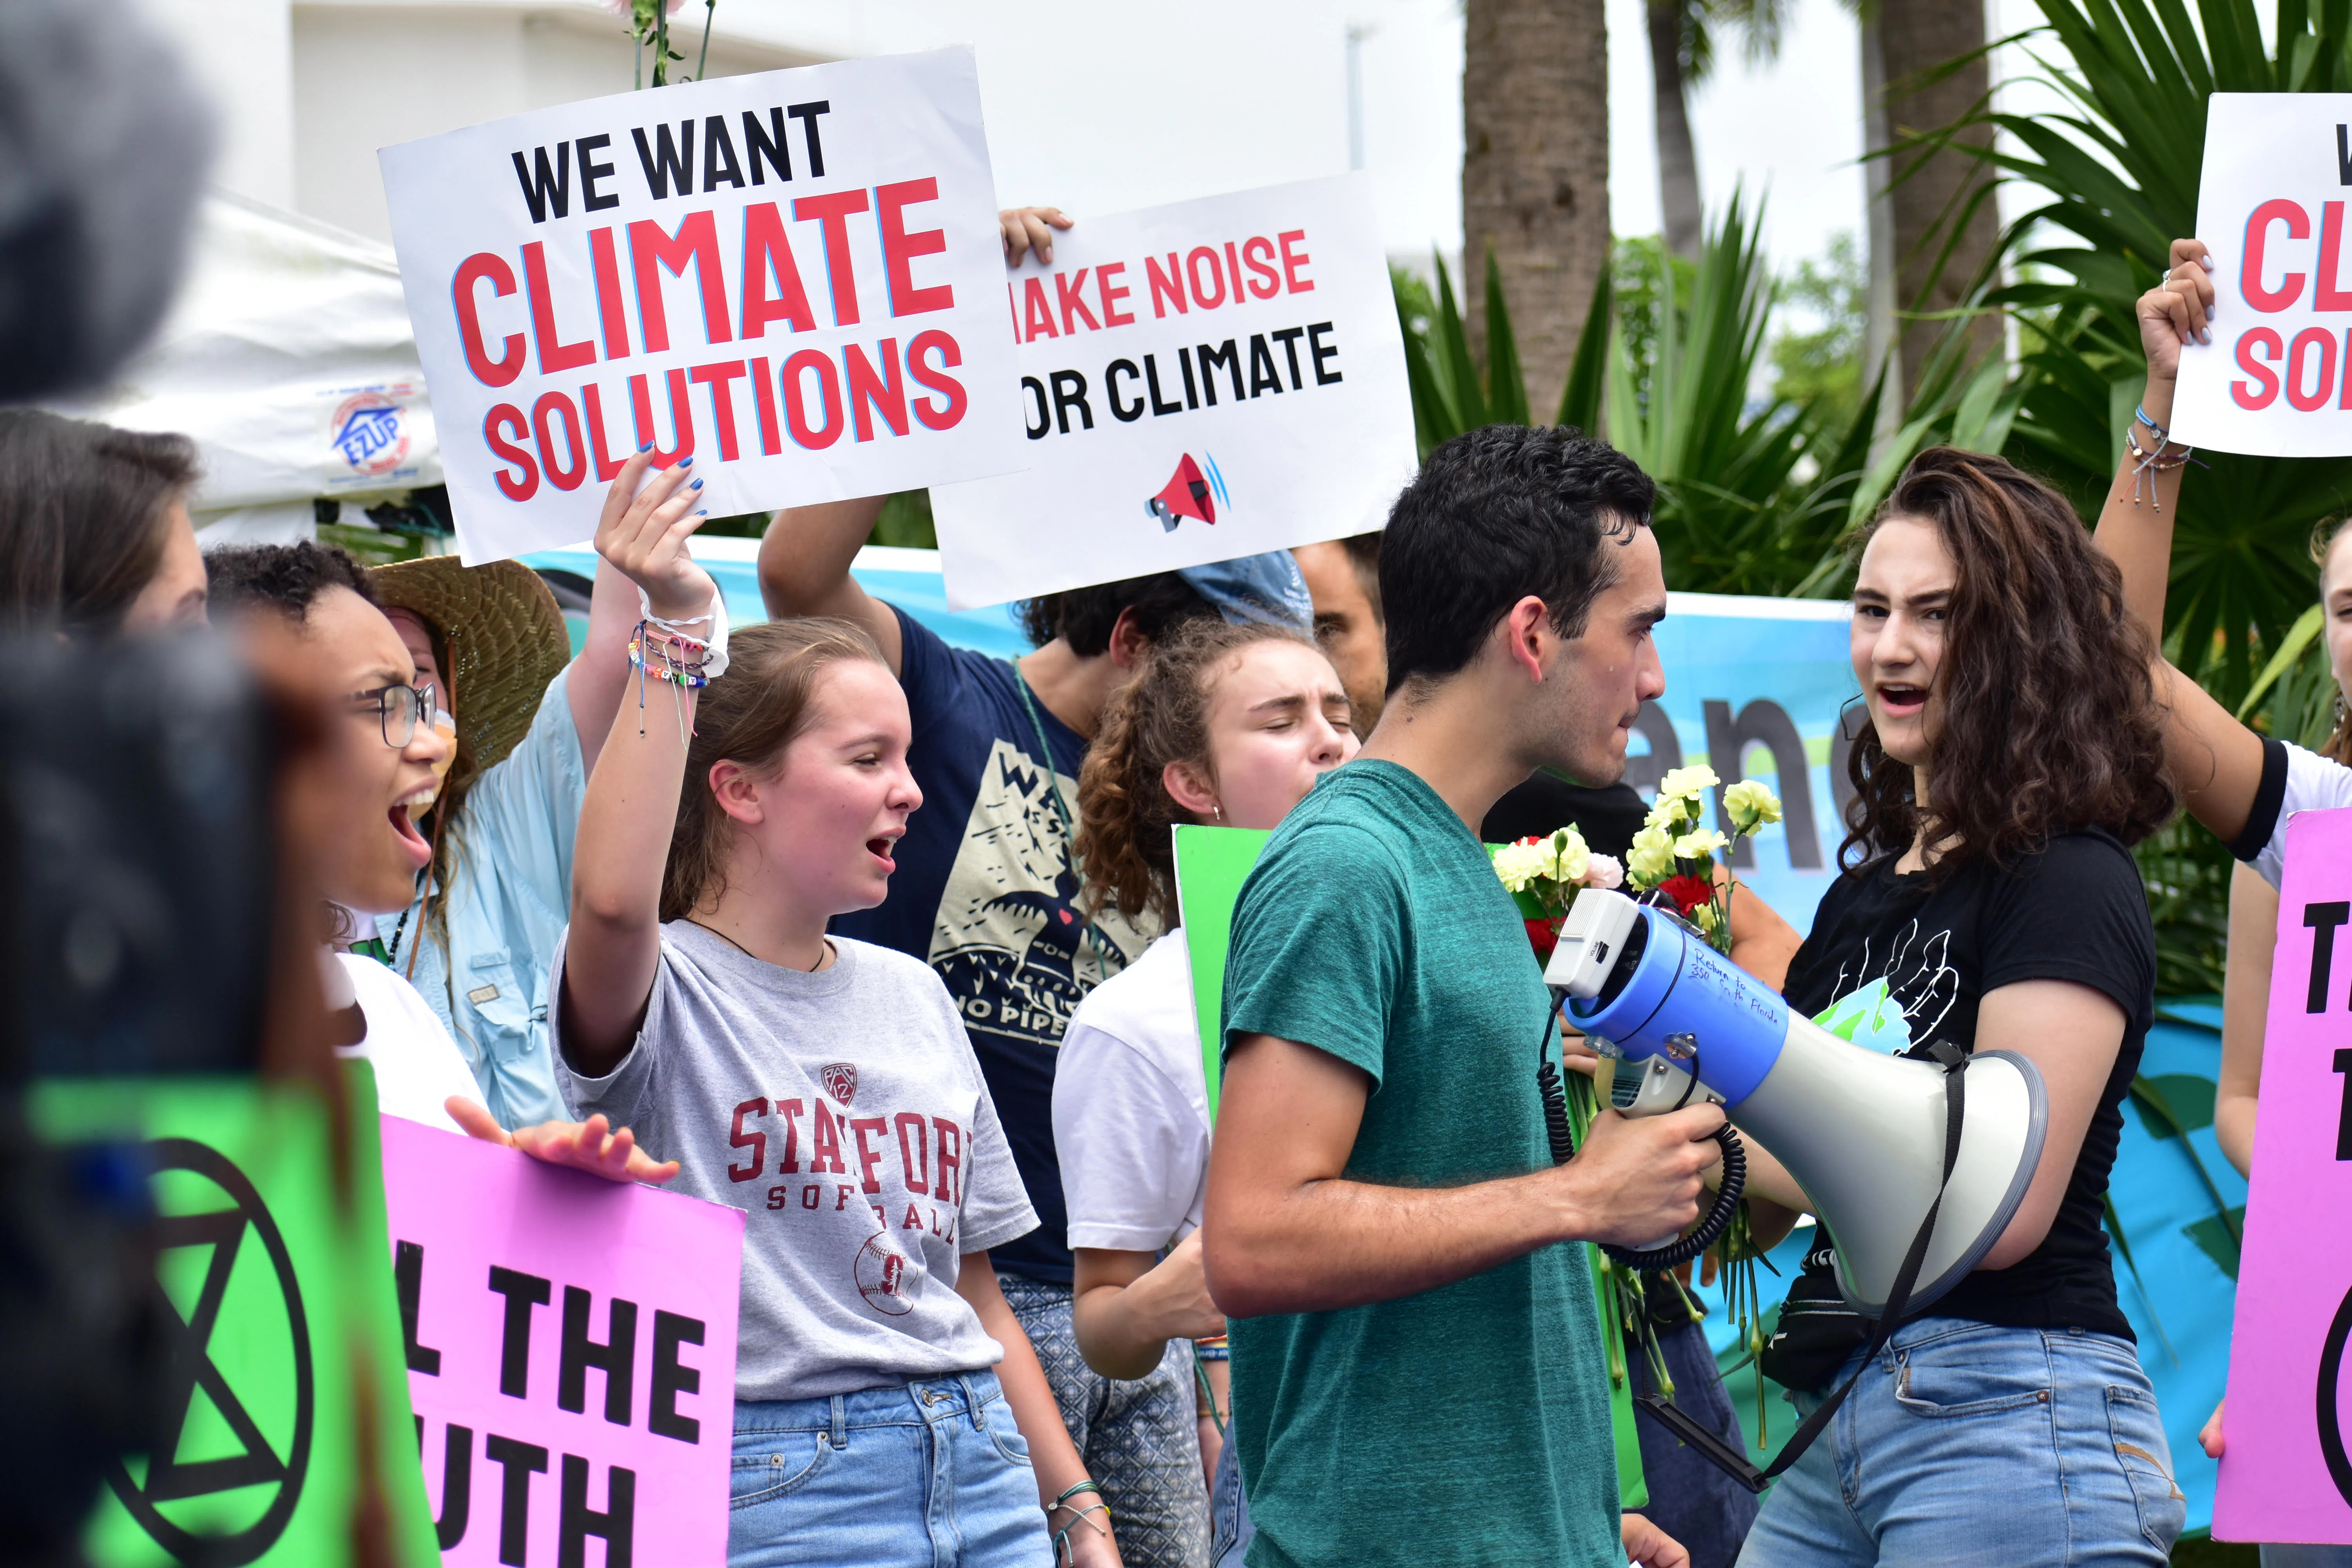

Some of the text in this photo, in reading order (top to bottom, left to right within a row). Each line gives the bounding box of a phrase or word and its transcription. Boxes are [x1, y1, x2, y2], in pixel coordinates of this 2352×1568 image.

[512, 100, 830, 224] WE WANT
[450, 176, 955, 388] CLIMATE
[1008, 229, 1315, 345] AKE NOISE
[482, 329, 967, 503] SOLUTIONS
[1105, 321, 1343, 422] CLIMATE
[1695, 948, 1746, 990] Return to
[824, 1066, 854, 1092] PAC
[833, 1083, 850, 1100] 12
[728, 1096, 973, 1207] STAFOR
[488, 1265, 705, 1445] THE
